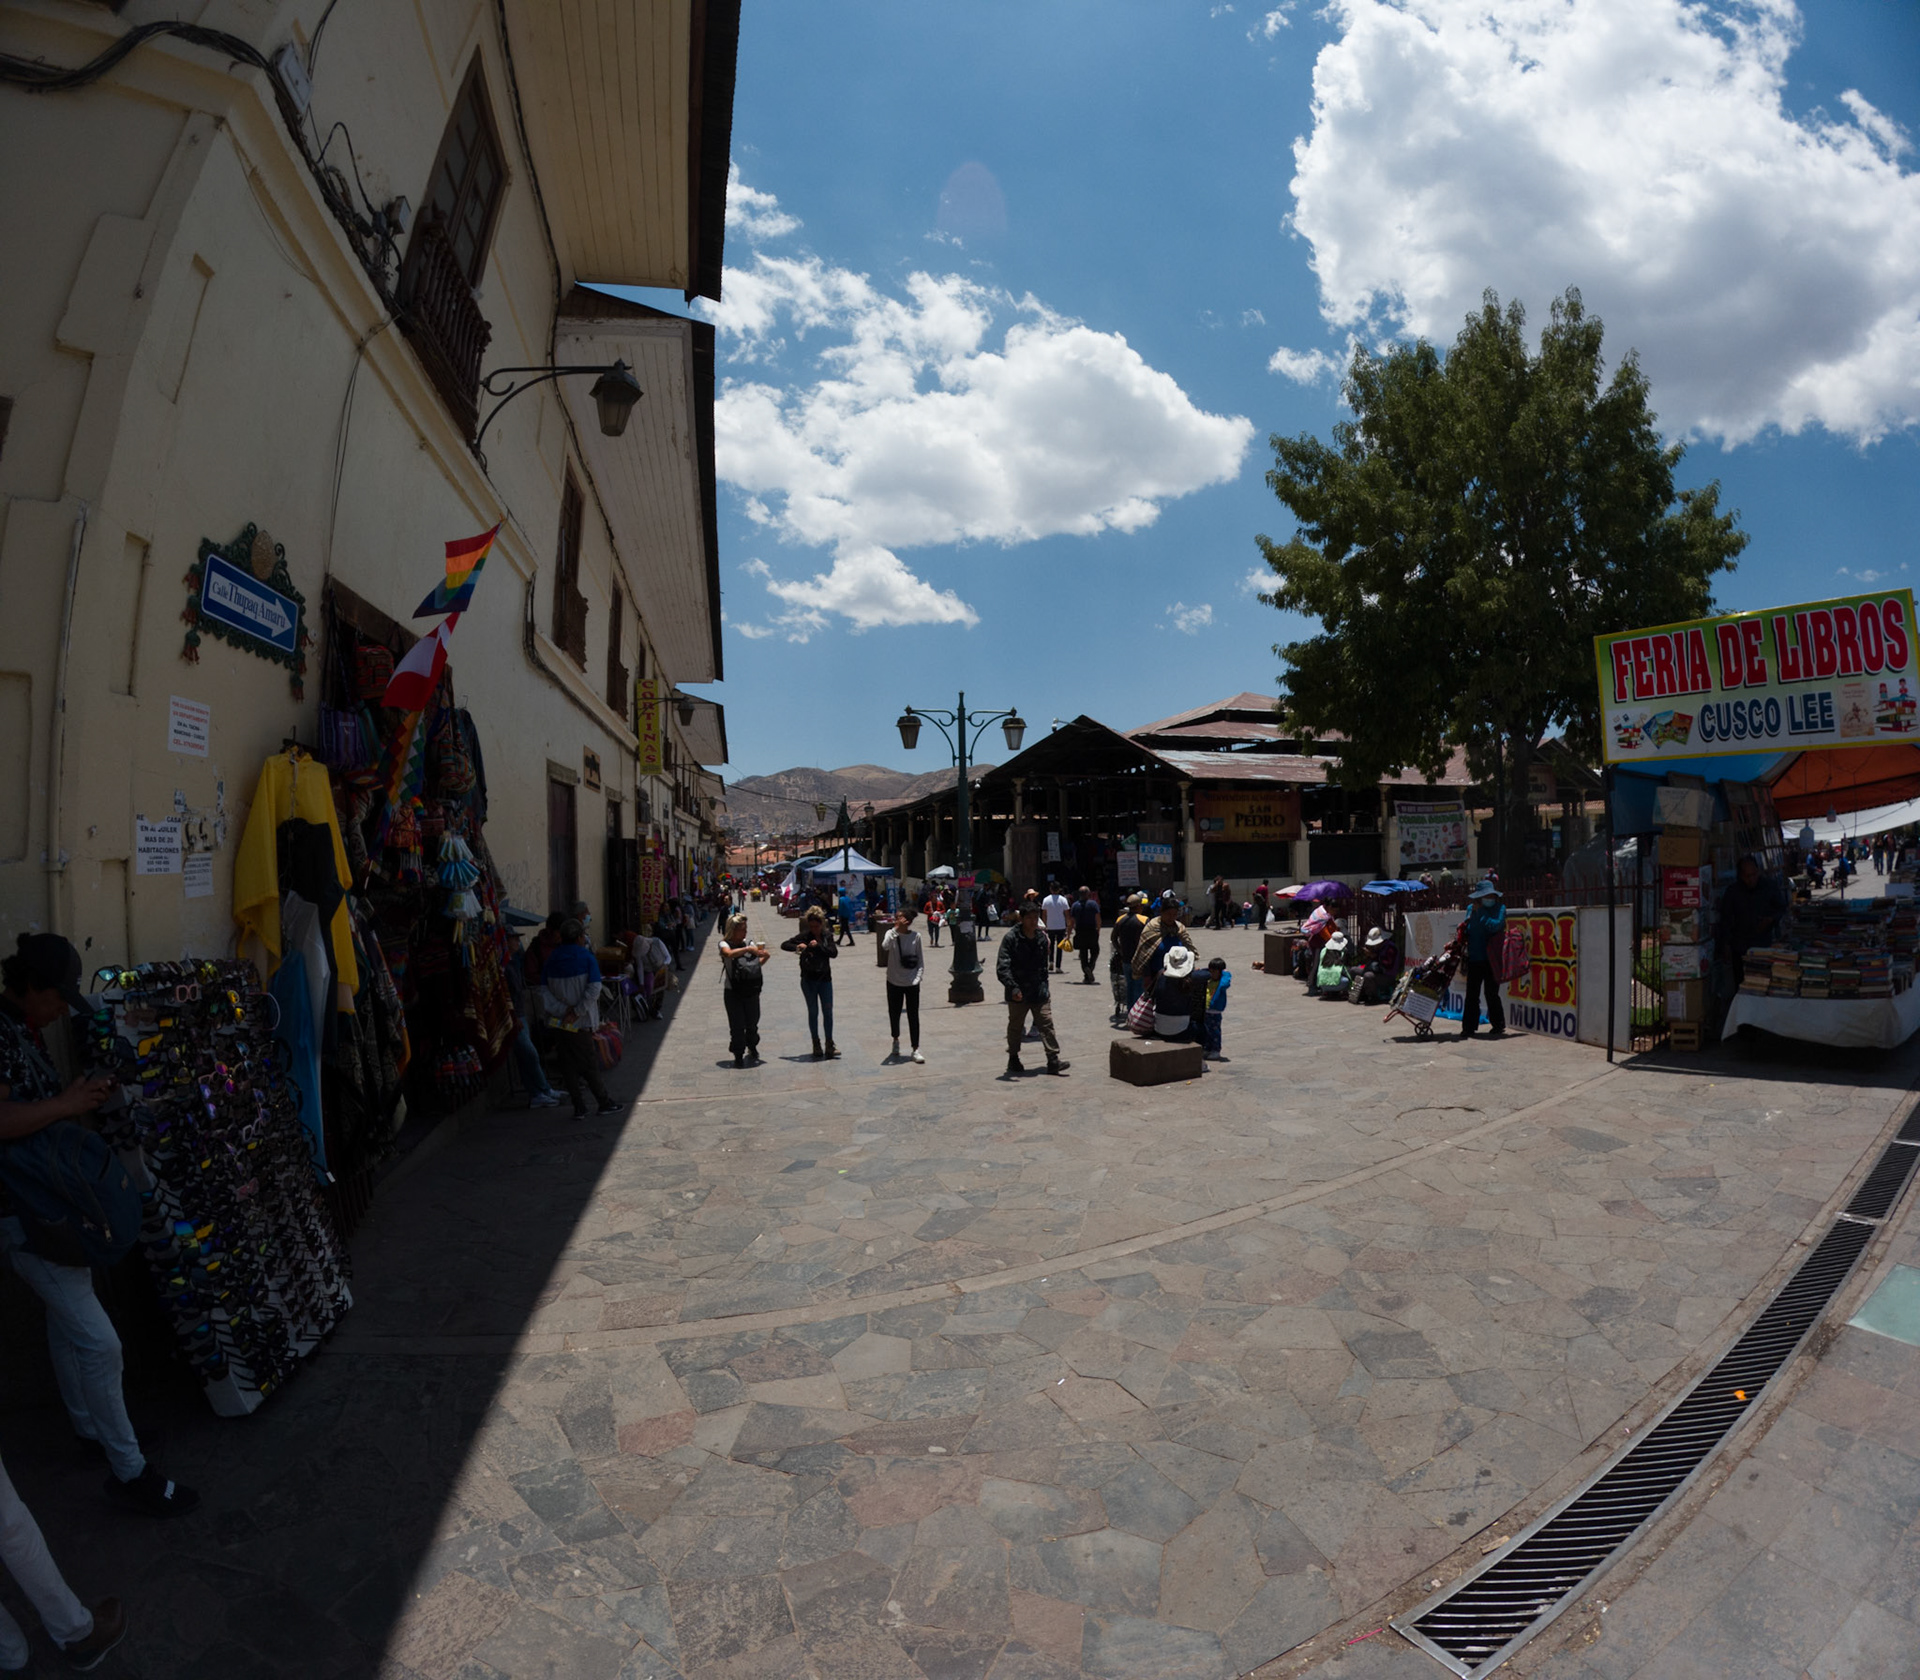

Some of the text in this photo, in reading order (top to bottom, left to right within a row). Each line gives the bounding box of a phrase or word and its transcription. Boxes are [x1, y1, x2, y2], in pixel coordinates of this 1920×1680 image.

[212, 581, 286, 627] Calle Thupaq Amaru
[1610, 598, 1909, 703] FERIA DE LIBROS
[1698, 691, 1835, 742] CUSCO LEE
[1235, 812, 1285, 827] PEDRO
[1249, 805, 1271, 814] SAN
[1510, 1003, 1576, 1037] MUNDO
